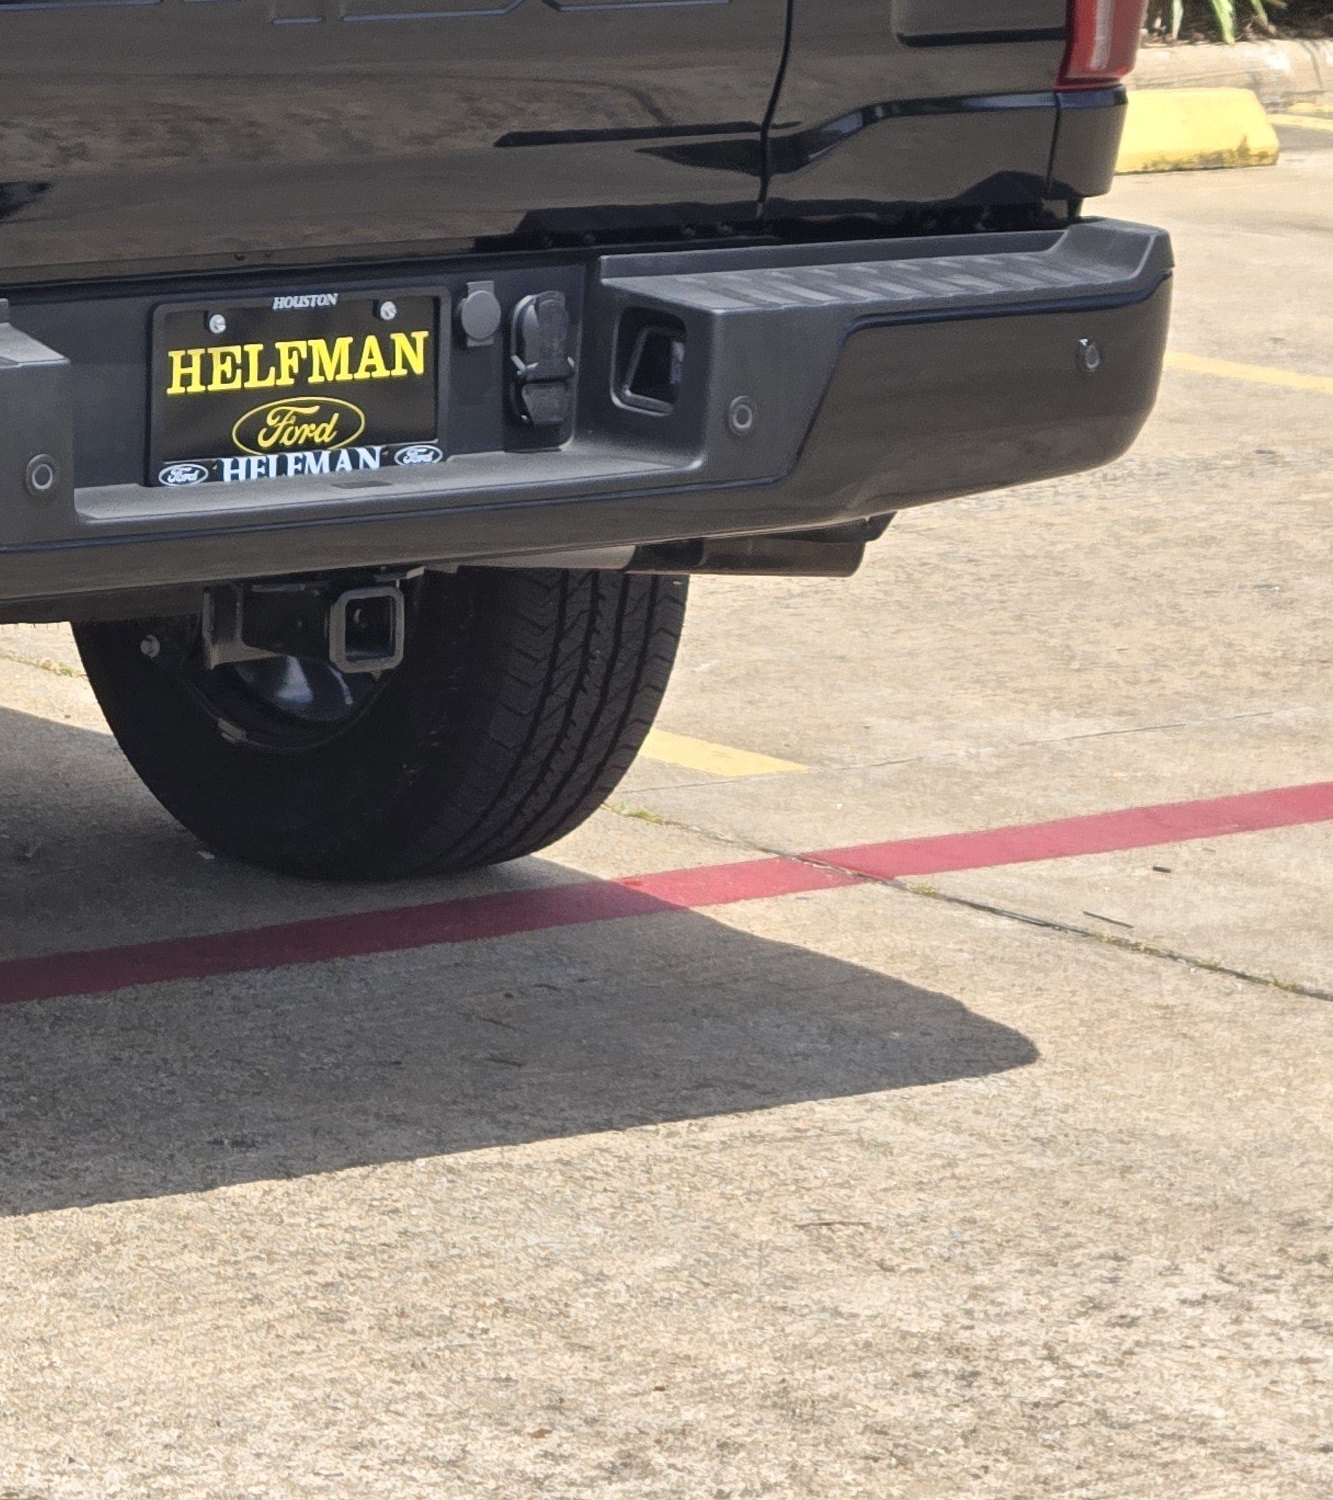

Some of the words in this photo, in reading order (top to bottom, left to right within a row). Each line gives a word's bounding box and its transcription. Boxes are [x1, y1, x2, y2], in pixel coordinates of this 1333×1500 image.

[272, 293, 339, 311] HOUSTON
[166, 331, 430, 395] HELFMAN
[257, 404, 340, 449] Ford
